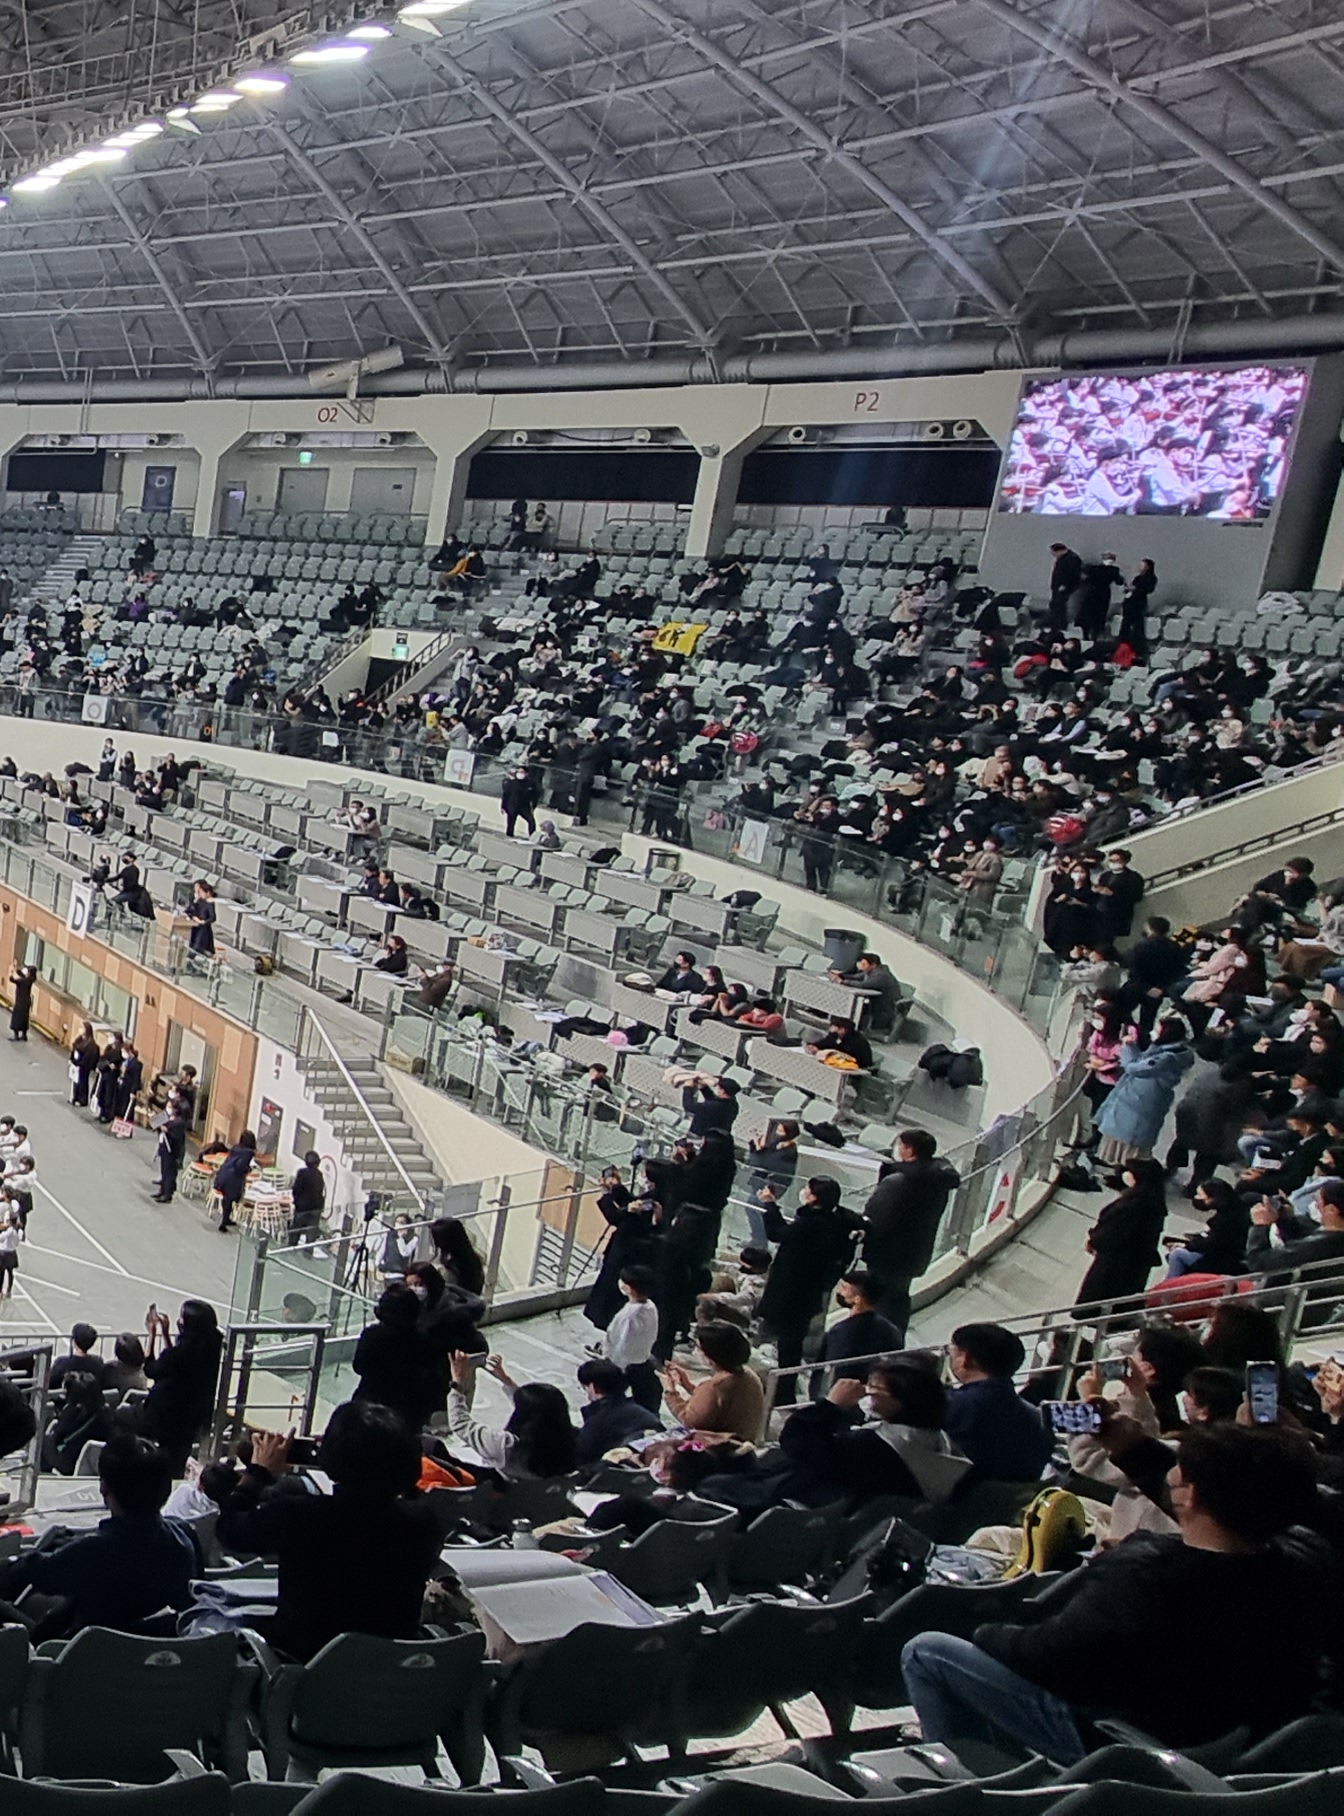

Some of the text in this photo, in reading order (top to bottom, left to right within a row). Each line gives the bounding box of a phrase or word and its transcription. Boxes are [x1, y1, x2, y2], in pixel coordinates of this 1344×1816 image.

[855, 392, 880, 412] P2
[317, 407, 338, 422] O2
[71, 895, 86, 930] D
